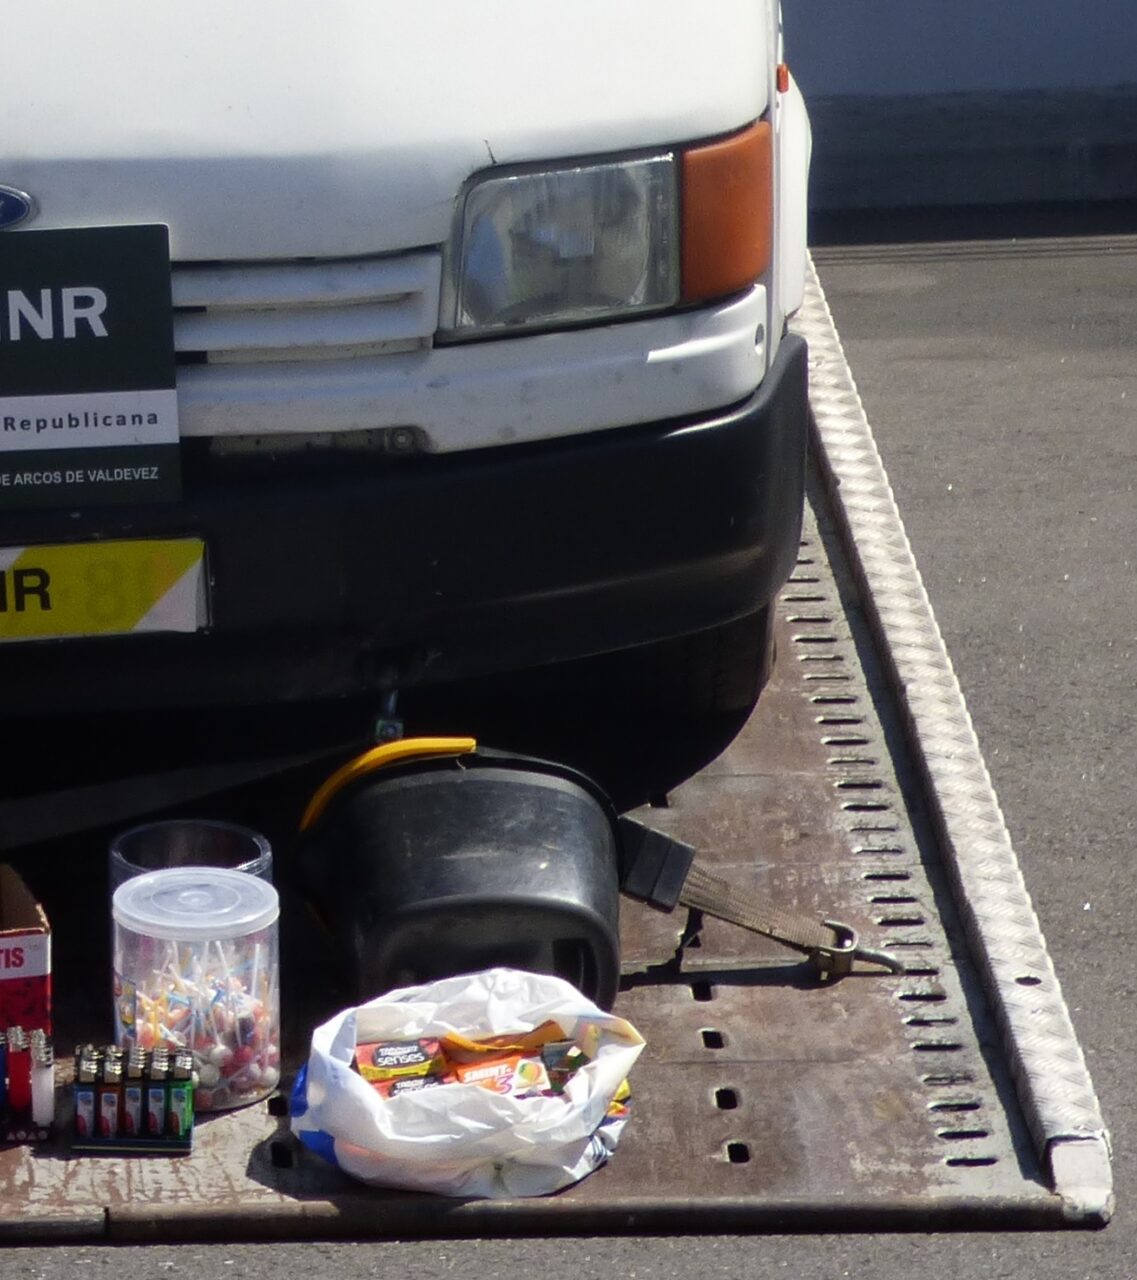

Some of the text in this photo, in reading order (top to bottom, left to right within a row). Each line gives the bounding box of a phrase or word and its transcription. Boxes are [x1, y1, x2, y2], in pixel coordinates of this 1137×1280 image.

[4, 412, 159, 434] Republicana
[14, 471, 62, 486] ARCOS
[66, 469, 84, 483] DE
[87, 467, 159, 483] VALDEVEZ
[377, 1052, 425, 1067] senses
